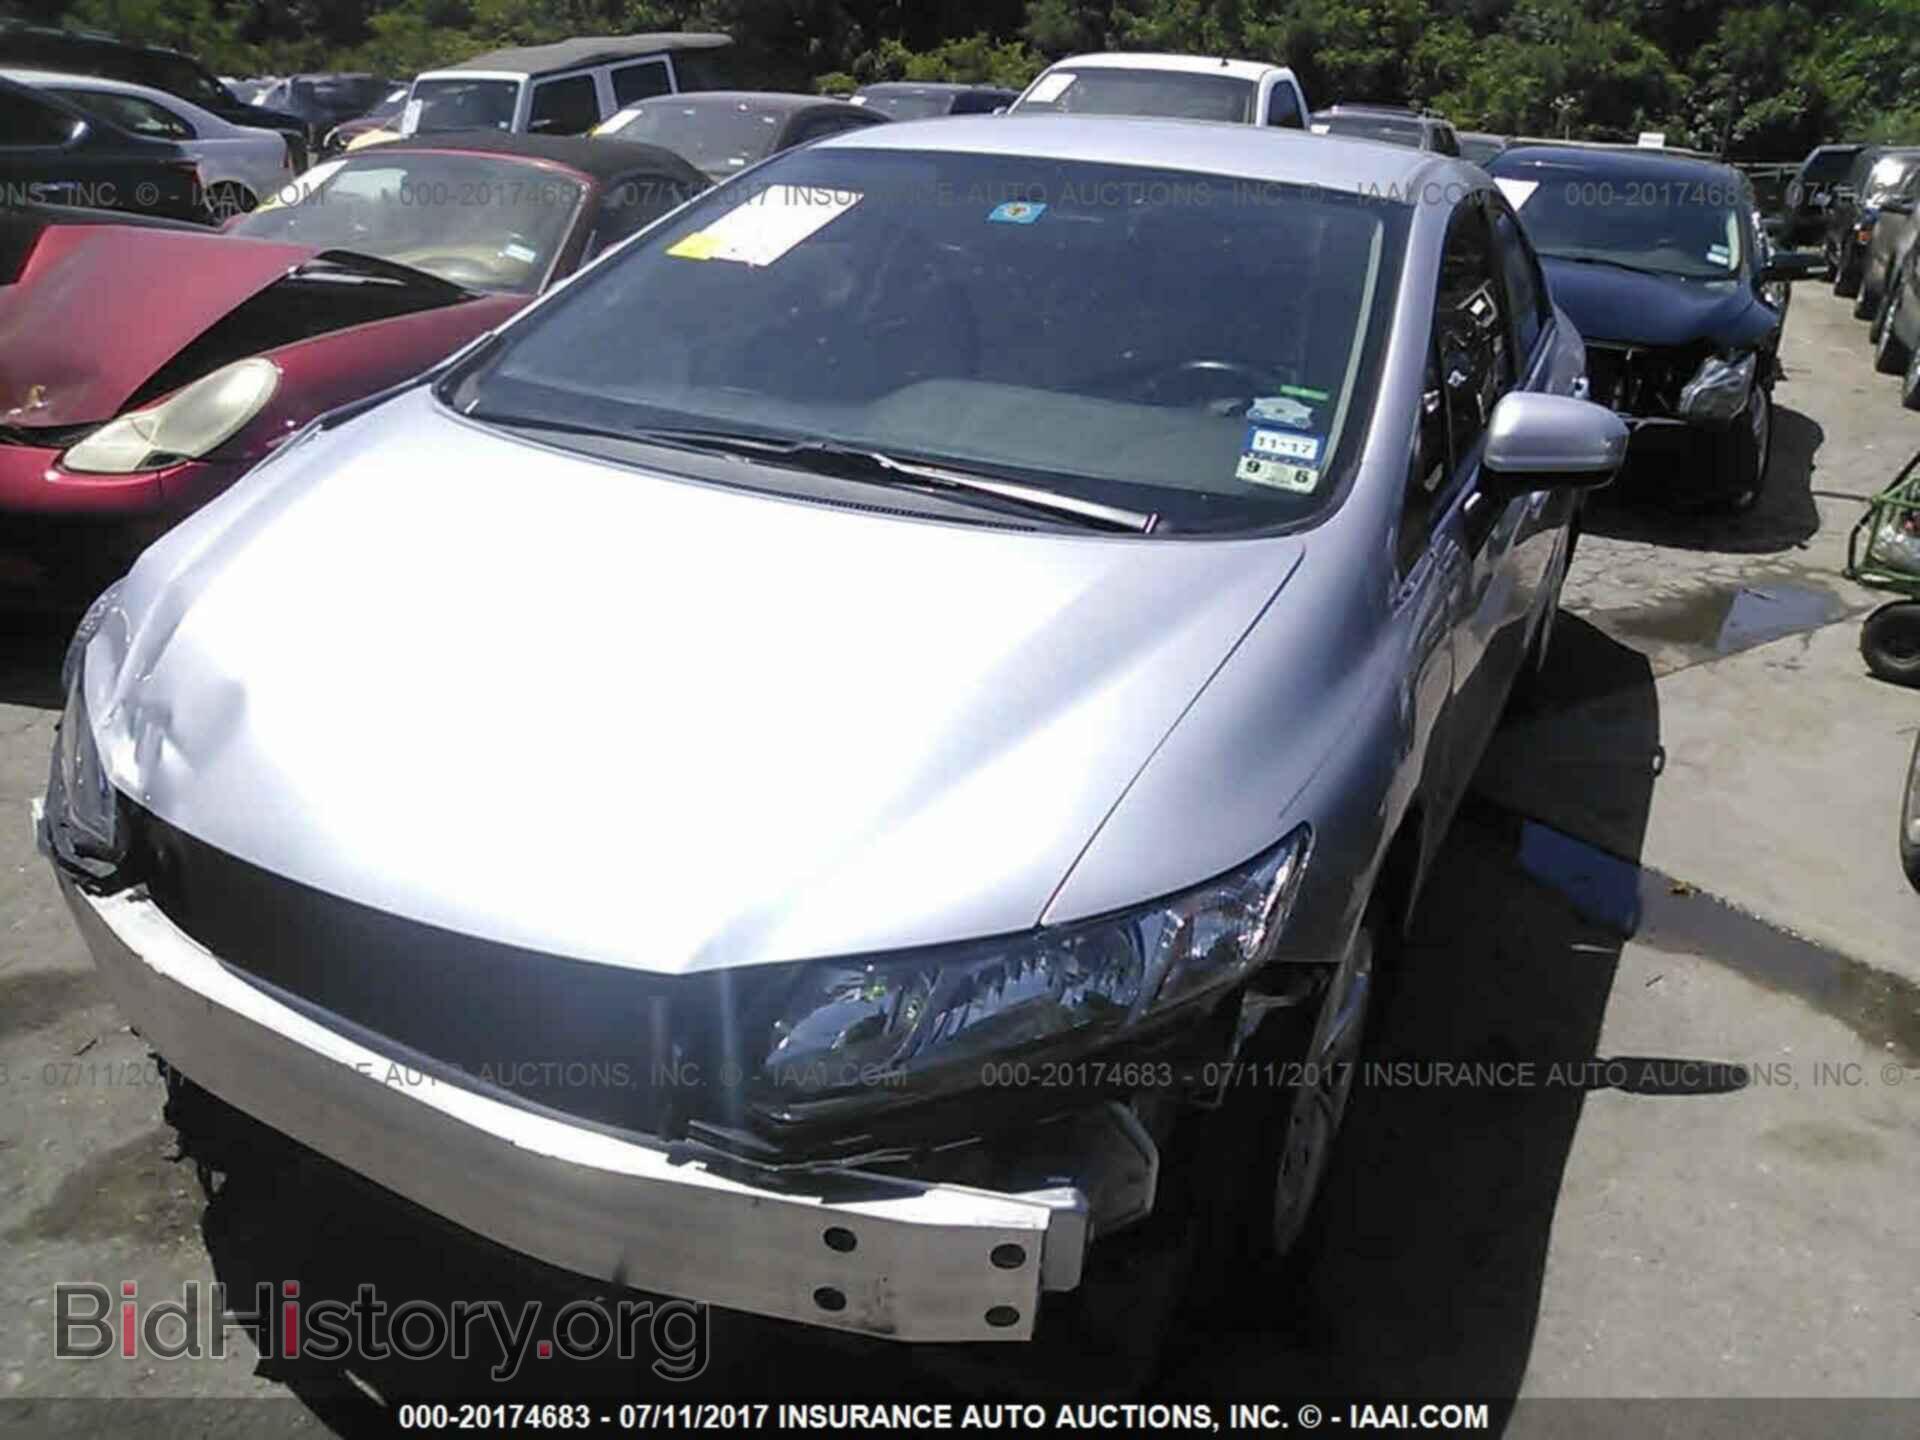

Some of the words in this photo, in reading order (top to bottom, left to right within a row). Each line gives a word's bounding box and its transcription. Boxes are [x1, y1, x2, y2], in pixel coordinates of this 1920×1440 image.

[1258, 436, 1312, 454] 11-17
[1246, 460, 1261, 474] 9
[1294, 469, 1309, 484] 6
